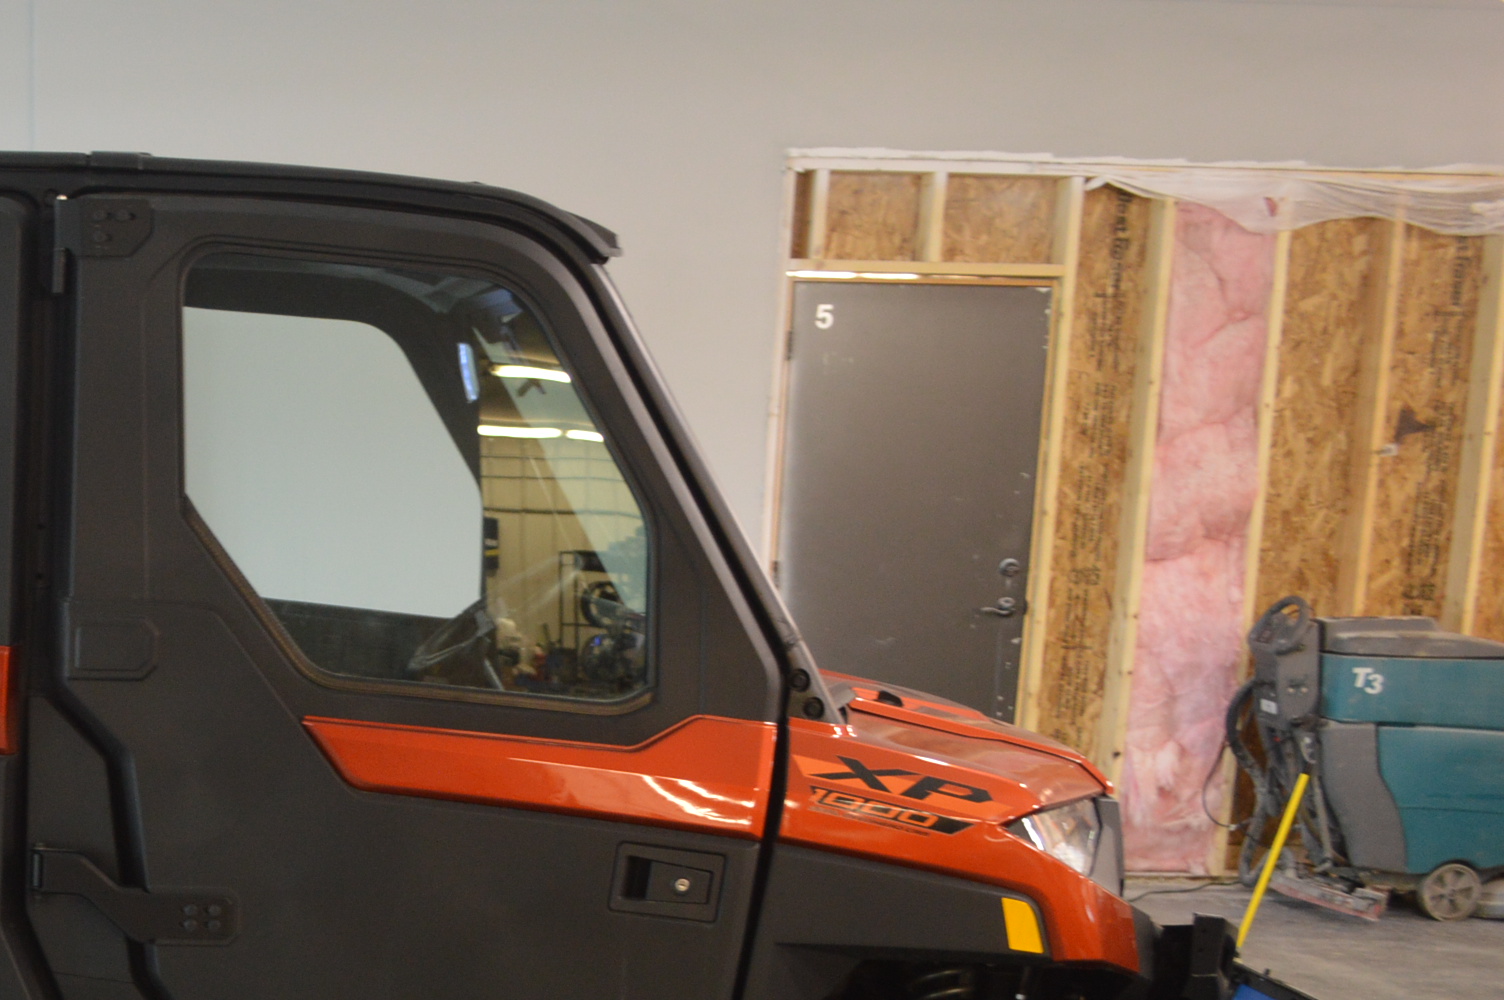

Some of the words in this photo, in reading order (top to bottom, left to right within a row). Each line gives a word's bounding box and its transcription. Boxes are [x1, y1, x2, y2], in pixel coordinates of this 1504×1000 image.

[815, 304, 834, 330] 5
[1352, 667, 1384, 695] T3
[807, 755, 994, 803] XP
[809, 788, 940, 828] 1000
